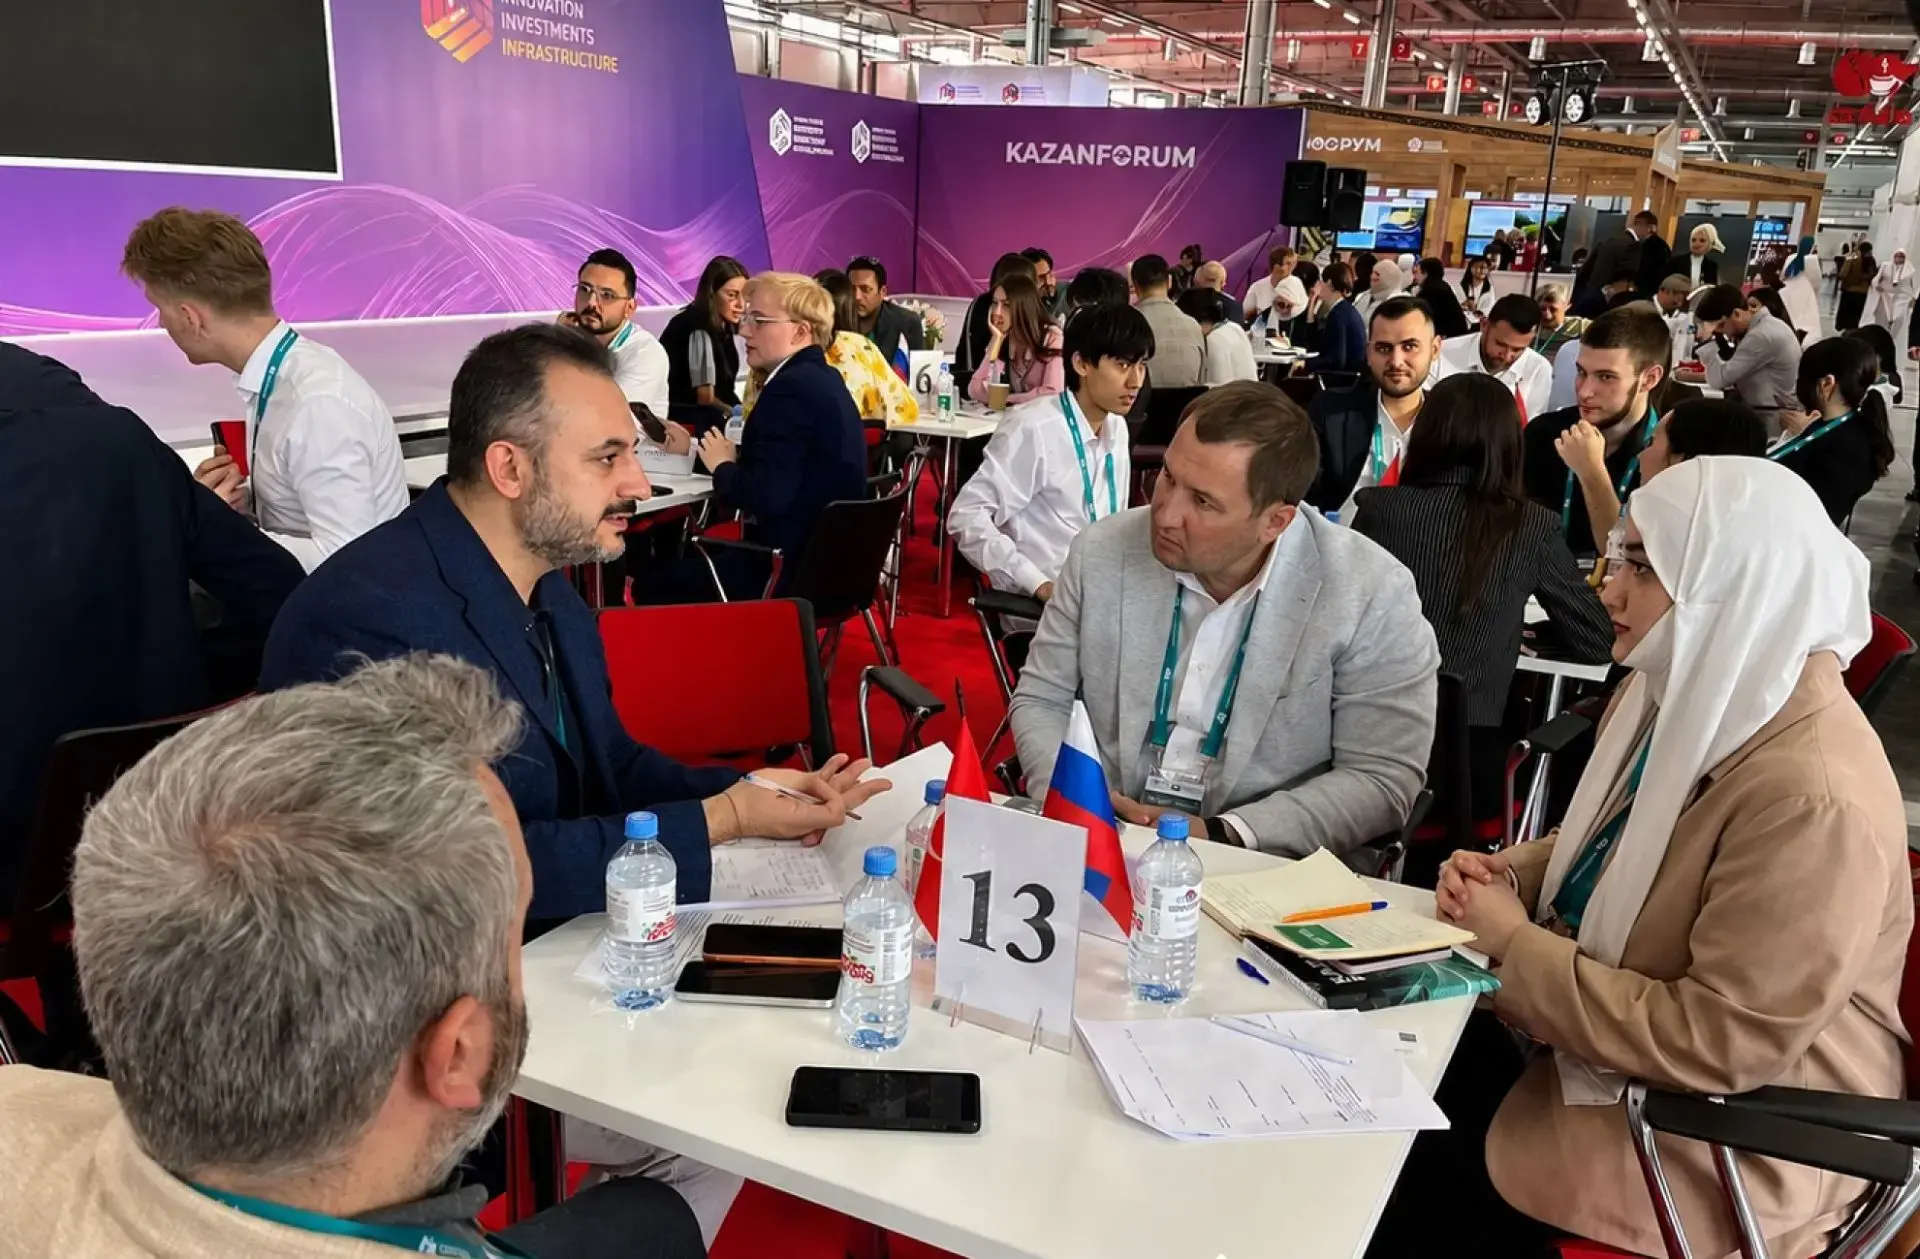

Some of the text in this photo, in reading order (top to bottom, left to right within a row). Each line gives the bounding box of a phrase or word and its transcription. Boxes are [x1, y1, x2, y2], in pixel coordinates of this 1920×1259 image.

[501, 0, 584, 18] OVATION
[501, 12, 595, 45] INVESTMENTS
[502, 38, 619, 73] INFRASTRUCTURE
[1005, 141, 1196, 168] KAZANFORUM
[915, 363, 932, 394] 6
[958, 869, 1057, 964] 13
